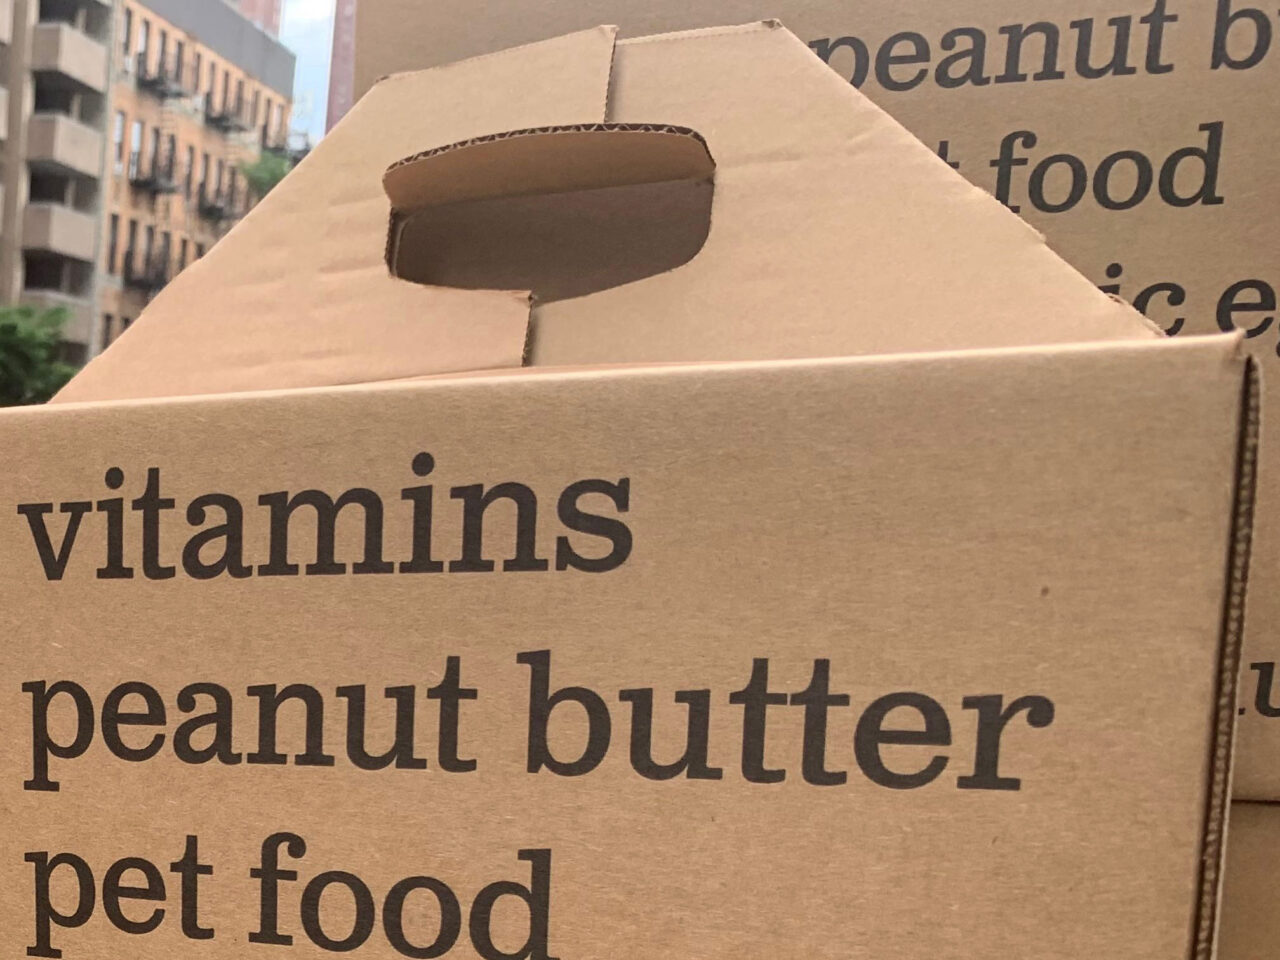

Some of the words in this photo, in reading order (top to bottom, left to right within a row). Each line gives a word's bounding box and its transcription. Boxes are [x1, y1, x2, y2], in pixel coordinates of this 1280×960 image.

[990, 121, 1225, 214] food
[17, 451, 634, 581] vitamins
[22, 655, 478, 792] peanut
[516, 649, 1056, 791] butter
[24, 834, 215, 960] pet
